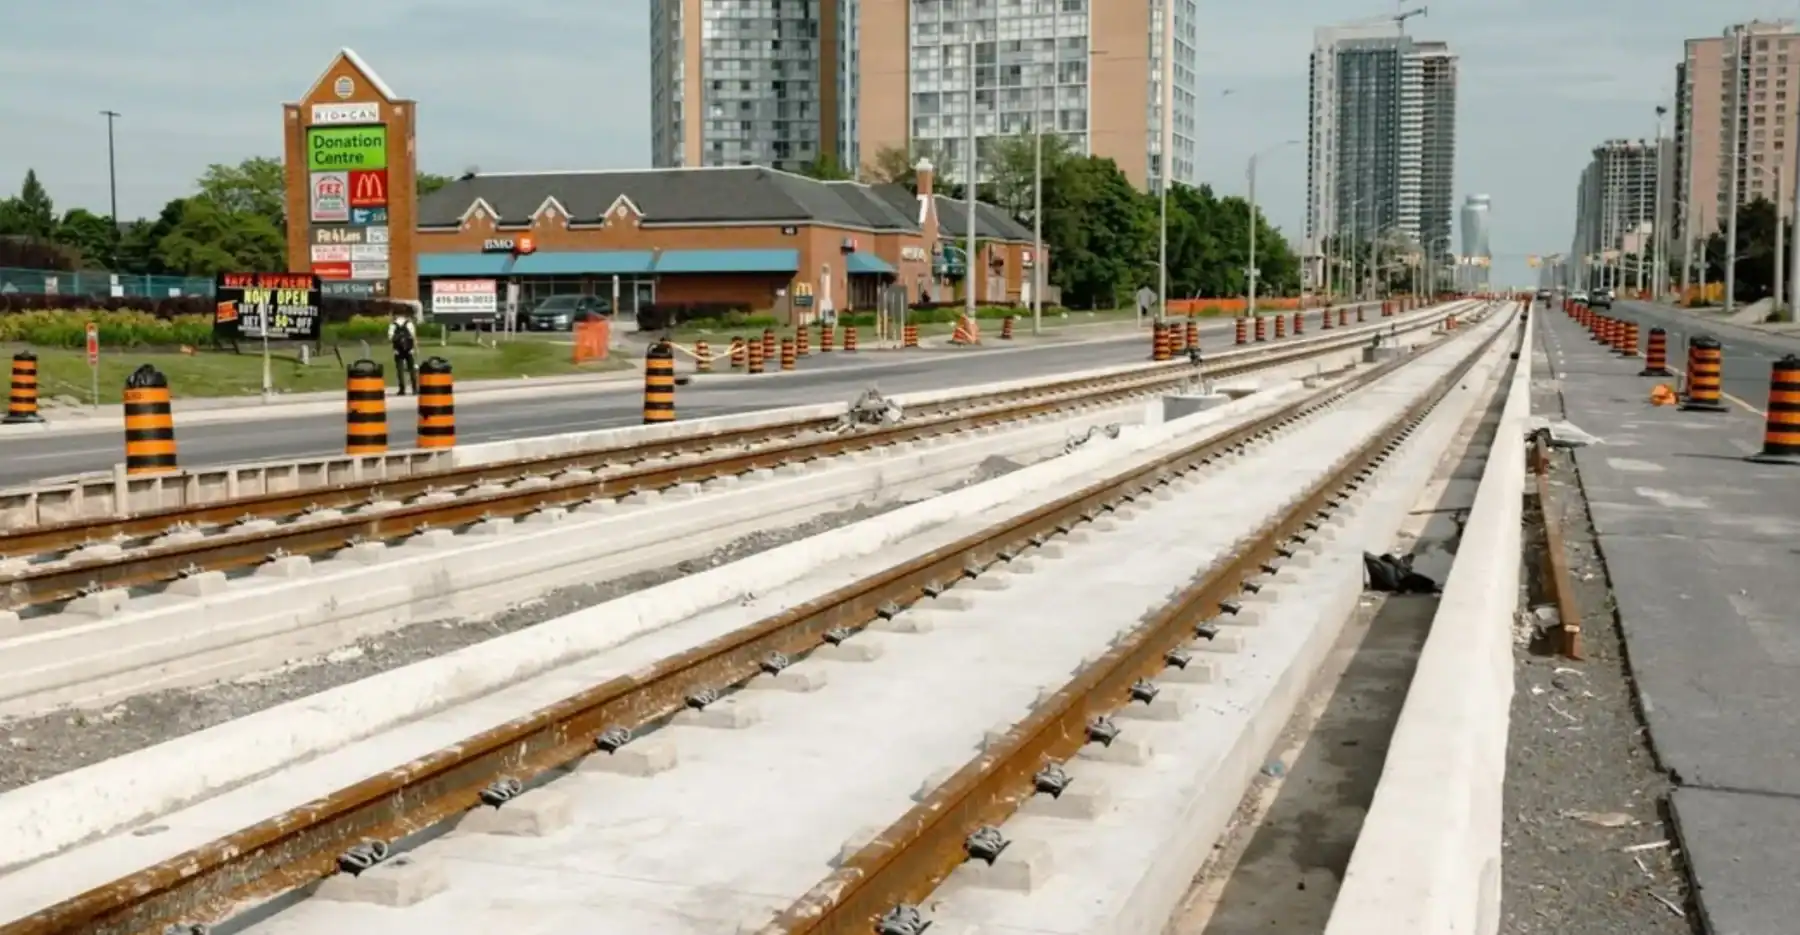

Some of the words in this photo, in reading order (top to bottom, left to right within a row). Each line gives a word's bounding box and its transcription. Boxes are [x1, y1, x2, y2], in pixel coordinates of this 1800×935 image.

[313, 134, 382, 149] Donation
[315, 151, 365, 165] Centre
[484, 239, 514, 249] BMO
[258, 274, 313, 289] SUPREME
[276, 289, 309, 305] OPEN
